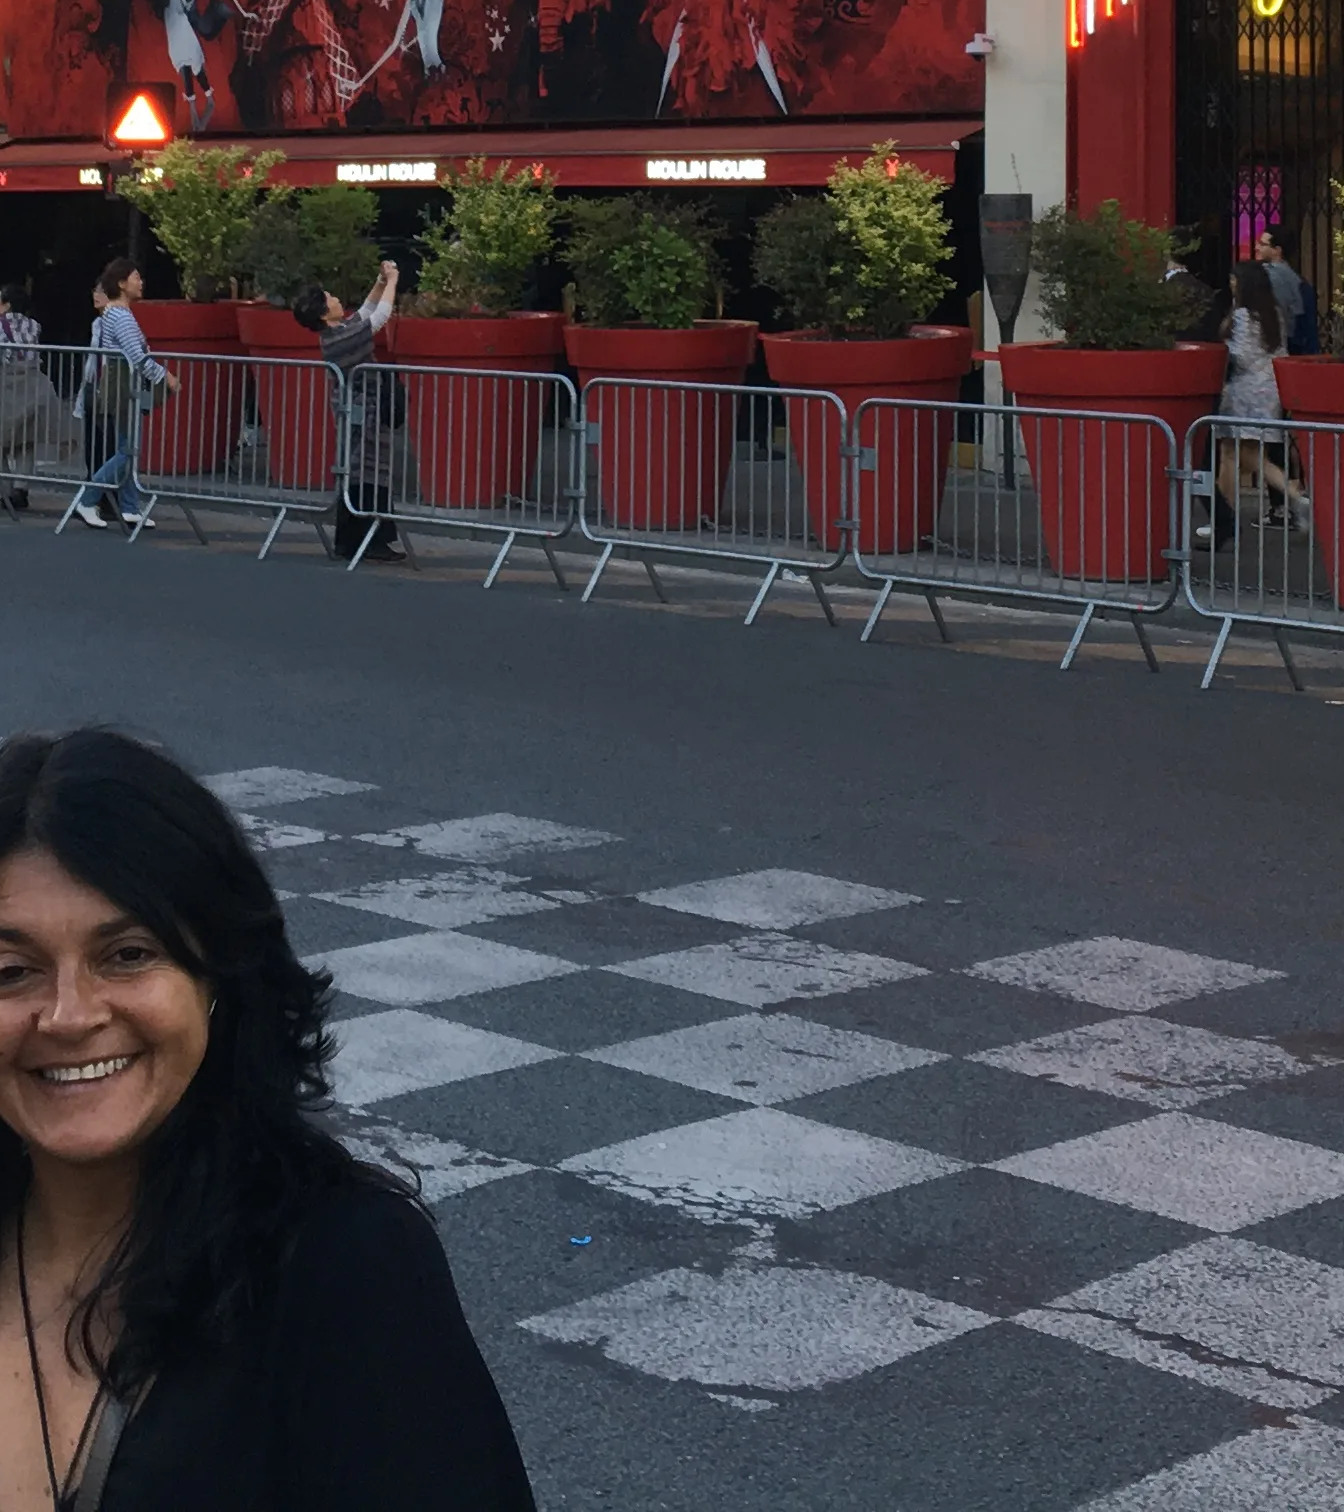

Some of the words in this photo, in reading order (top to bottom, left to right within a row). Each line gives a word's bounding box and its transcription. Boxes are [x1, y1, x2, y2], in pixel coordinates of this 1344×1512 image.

[336, 163, 386, 183] MOULIN
[388, 162, 437, 182] ROUGE
[646, 159, 707, 180] MOULIN
[708, 158, 767, 180] ROUGE
